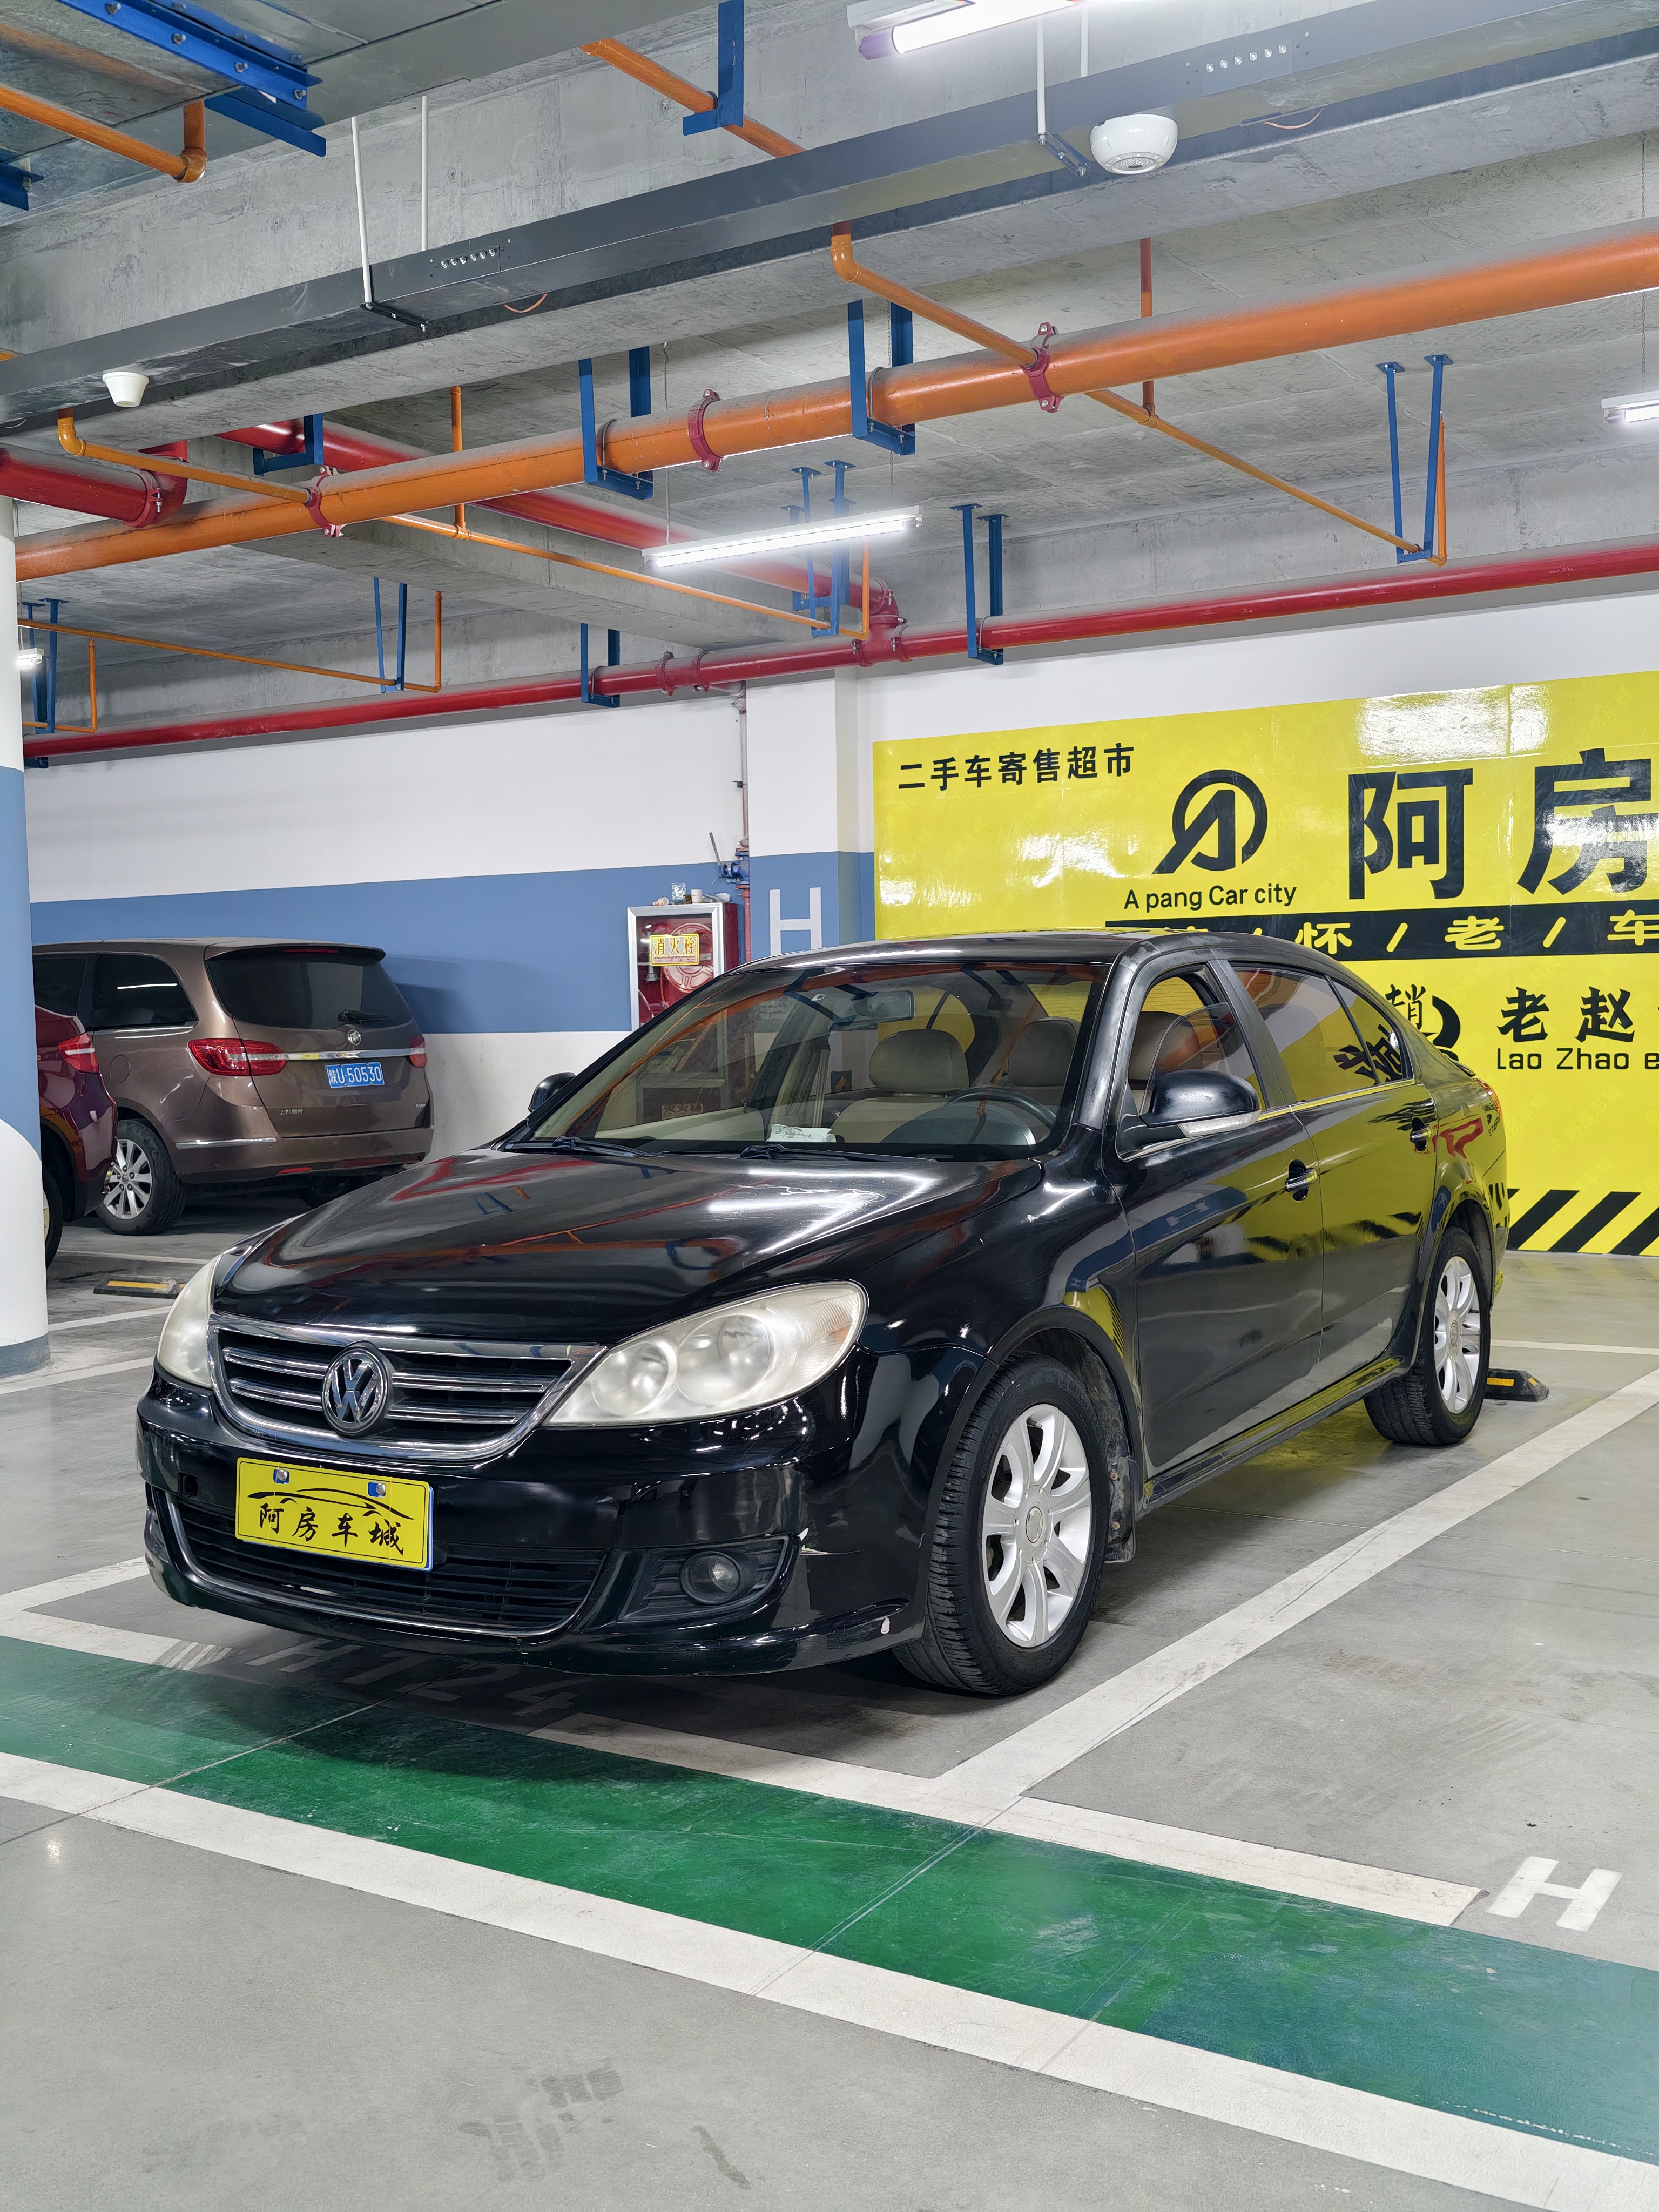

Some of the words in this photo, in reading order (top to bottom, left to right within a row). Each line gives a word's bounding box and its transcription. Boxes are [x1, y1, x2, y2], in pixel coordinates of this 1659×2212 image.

[899, 743, 1134, 791] 二手车寄售超市
[1348, 748, 1659, 900] 阿房
[770, 887, 822, 956] H
[1124, 889, 1140, 909] A
[1146, 891, 1202, 913] pang
[1209, 885, 1249, 906] Car
[1255, 882, 1297, 907] city
[653, 937, 696, 955] 消火栓
[1496, 986, 1635, 1043] 老赵
[1497, 1048, 1542, 1070] Lao
[1556, 1048, 1629, 1070] Zhao
[258, 1502, 404, 1556] 阿房车城
[1487, 1856, 1623, 1932] H
